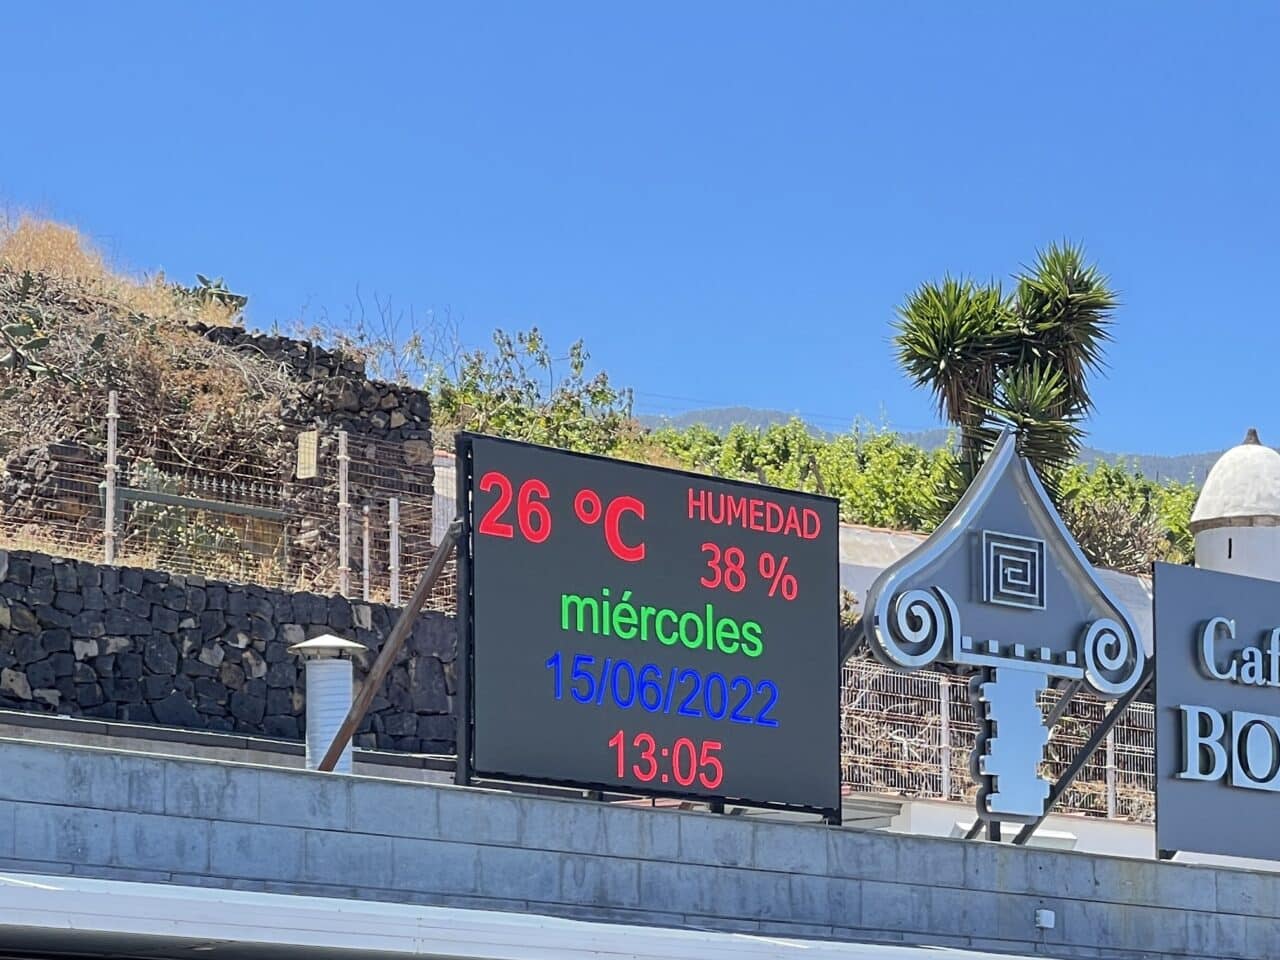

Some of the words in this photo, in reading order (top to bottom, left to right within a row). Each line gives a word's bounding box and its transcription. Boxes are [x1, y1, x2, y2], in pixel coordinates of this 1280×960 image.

[479, 471, 552, 543] 26
[687, 487, 821, 540] HUMEDAD
[700, 543, 747, 592] 38
[759, 552, 798, 601] %
[560, 587, 765, 657] miércoles
[545, 650, 780, 728] 15/06/2022
[608, 729, 724, 790] 13:05
